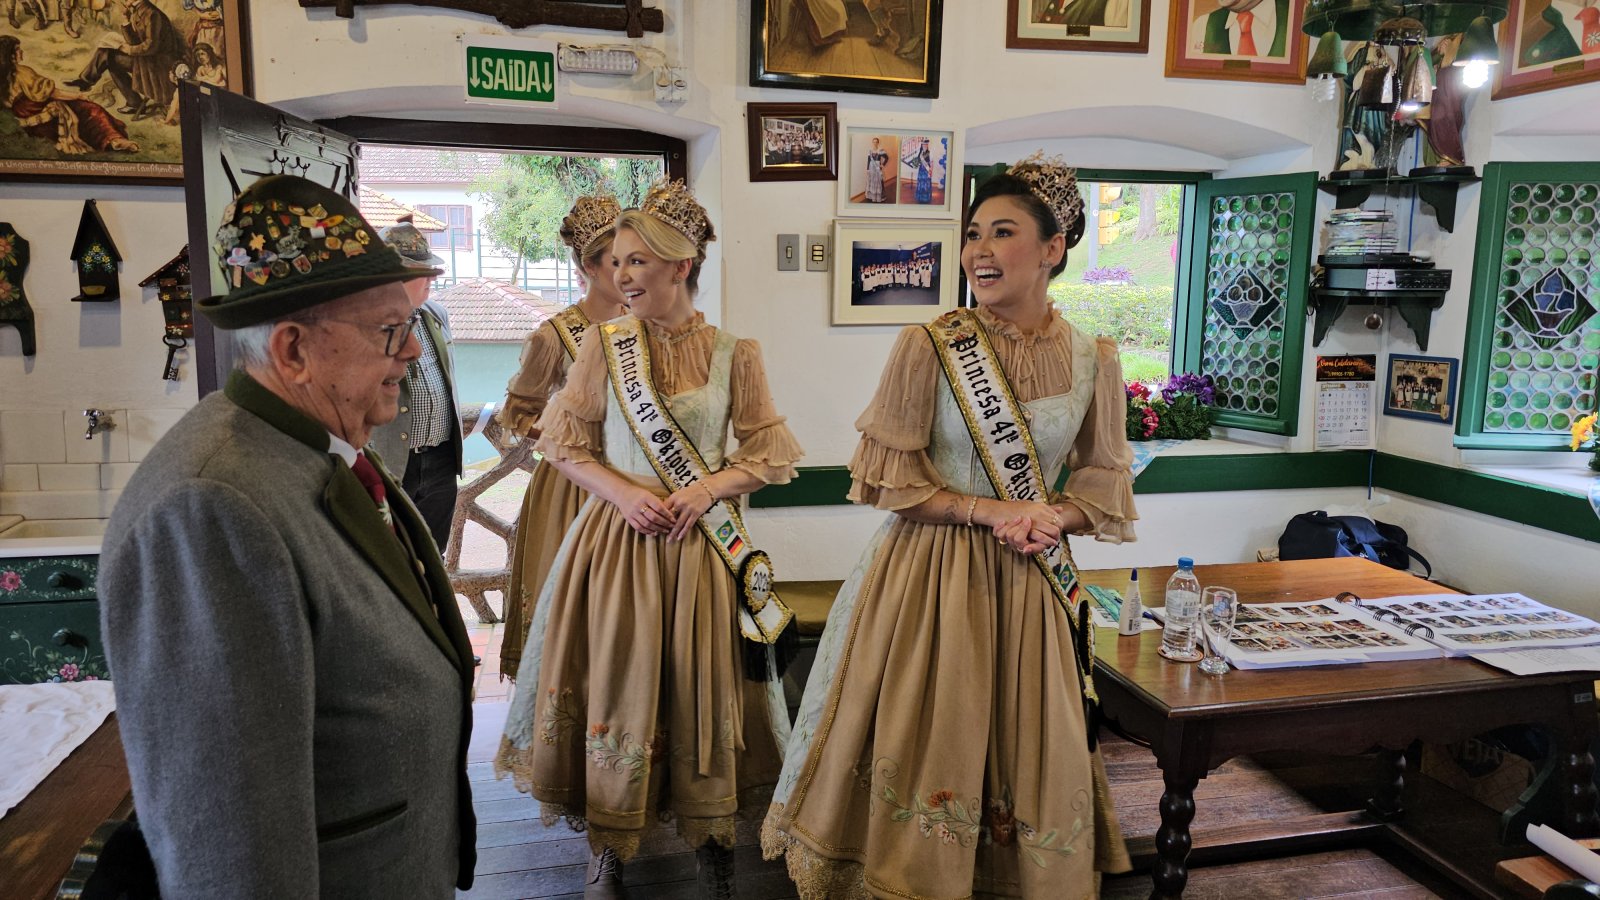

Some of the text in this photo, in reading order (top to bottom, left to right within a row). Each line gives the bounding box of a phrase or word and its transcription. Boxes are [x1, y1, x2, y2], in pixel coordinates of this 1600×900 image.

[614, 334, 642, 402] Princesa
[651, 429, 700, 487] Oktober
[949, 332, 1001, 420] Princesa
